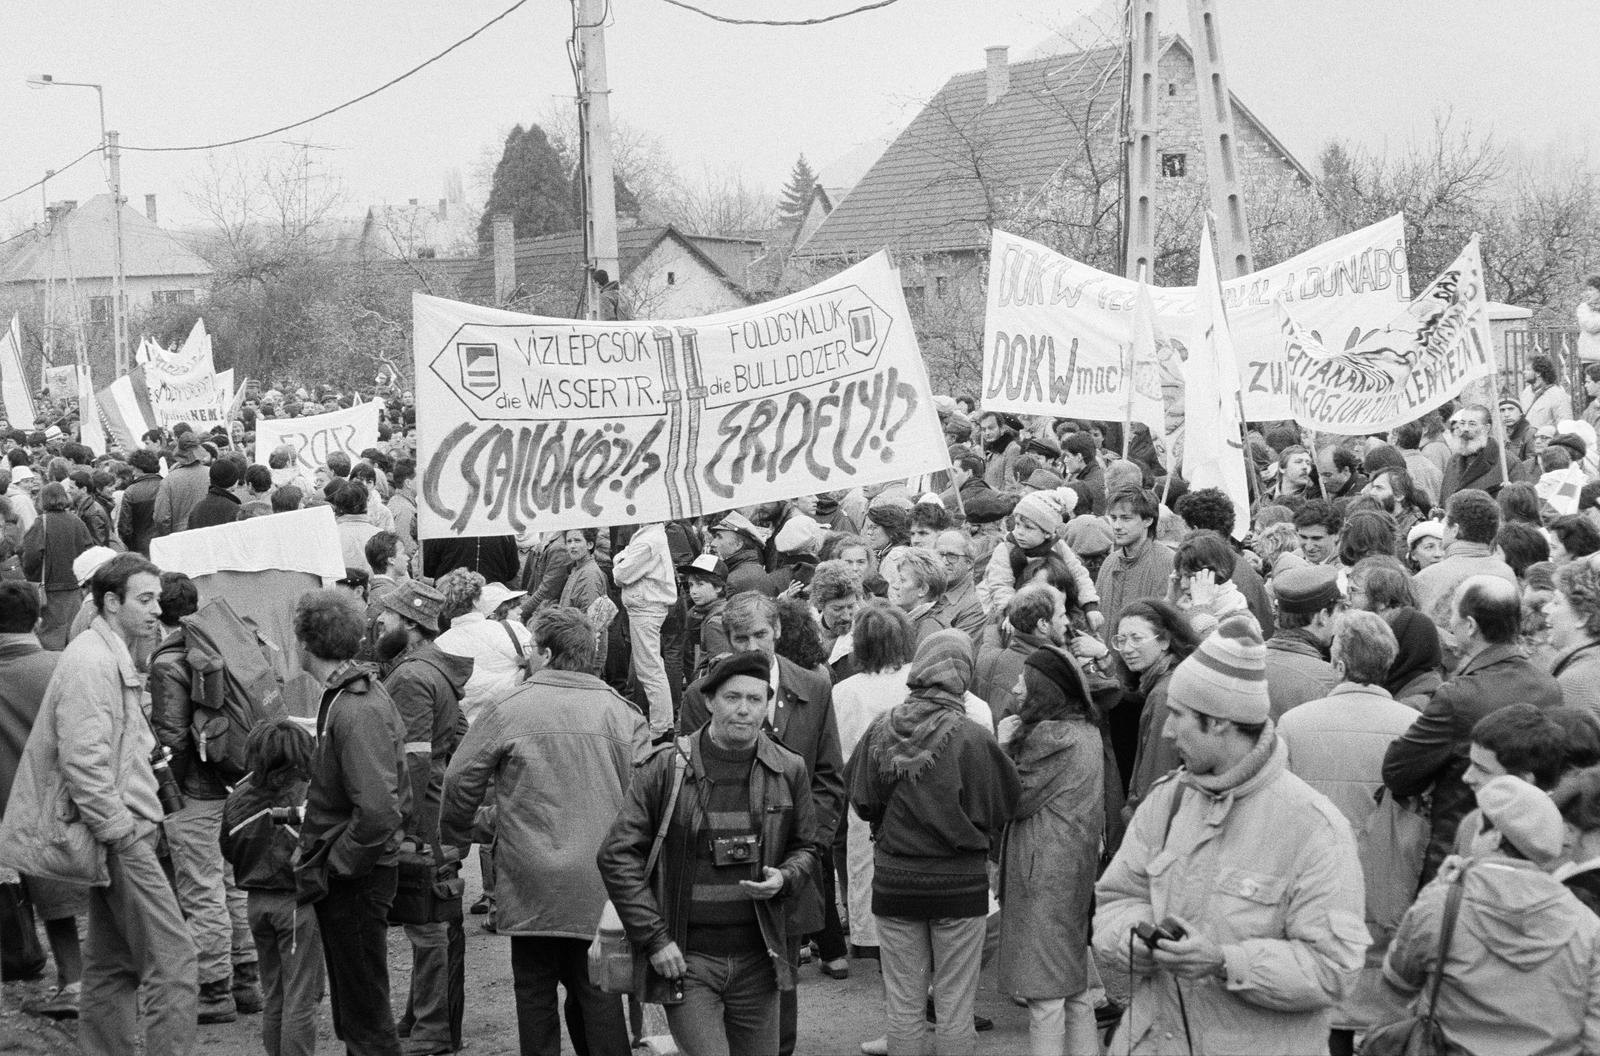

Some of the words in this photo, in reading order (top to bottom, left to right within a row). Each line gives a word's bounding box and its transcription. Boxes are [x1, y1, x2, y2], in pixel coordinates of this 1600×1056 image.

[709, 375, 732, 396] die
[733, 339, 850, 393] BULLDOZER
[986, 331, 1079, 405] DOKW
[496, 392, 522, 410] die
